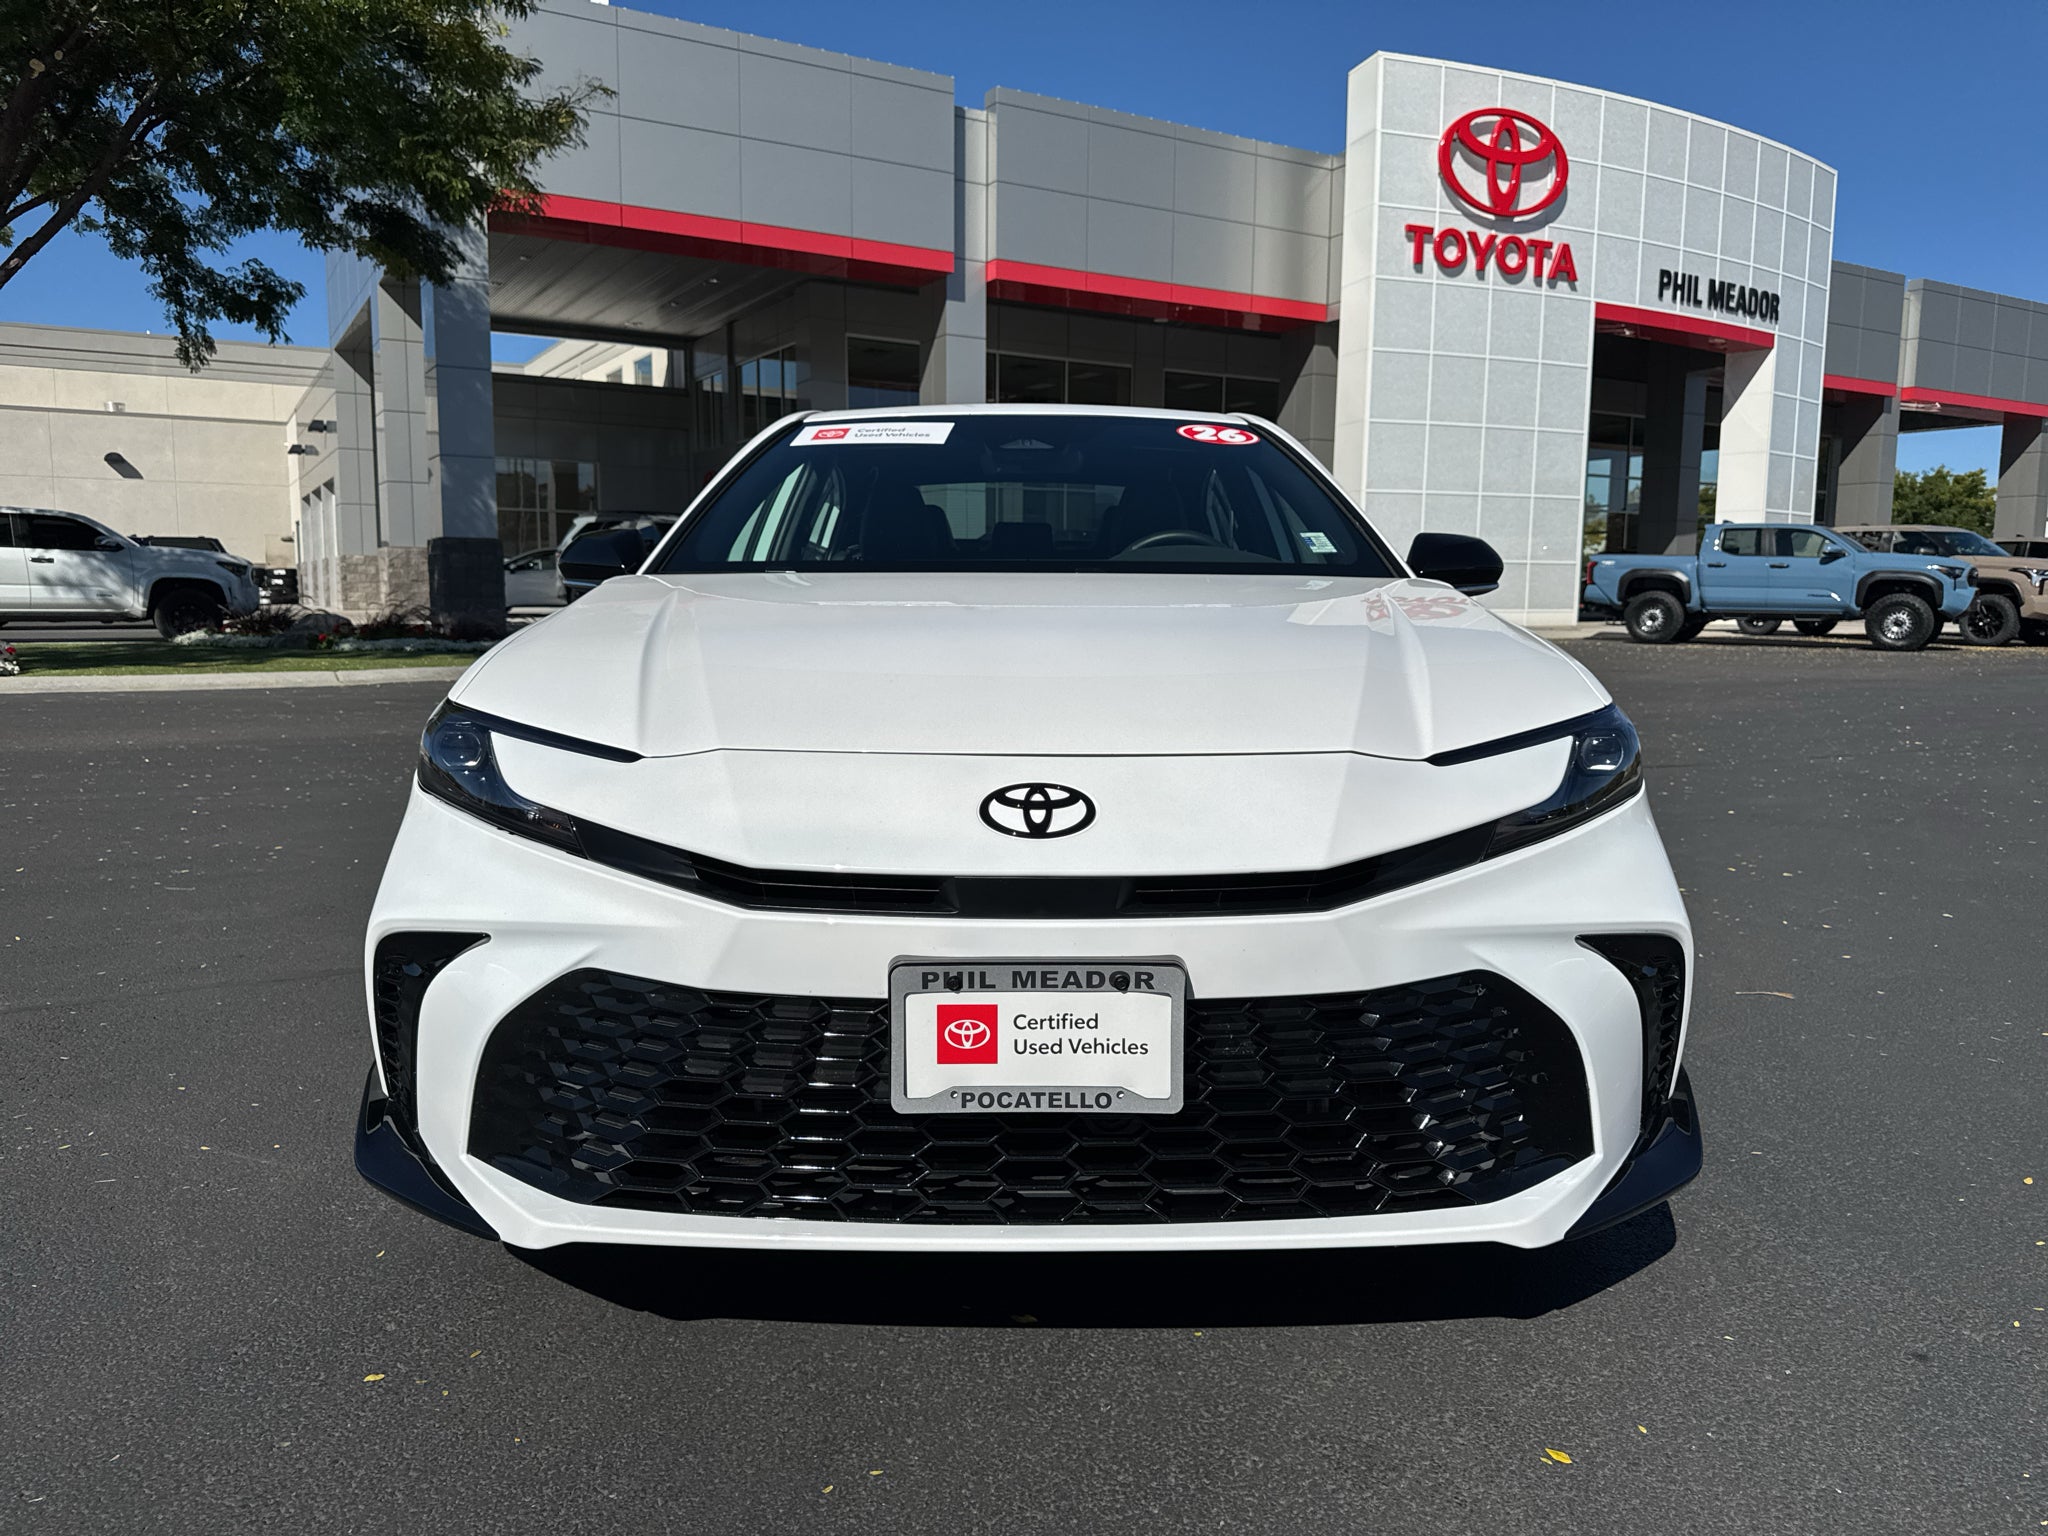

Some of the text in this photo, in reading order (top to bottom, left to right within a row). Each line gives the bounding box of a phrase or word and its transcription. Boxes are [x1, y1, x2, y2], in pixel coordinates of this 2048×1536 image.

[1405, 224, 1578, 282] TOYOTA
[1659, 269, 1780, 323] PHIL MEADOR
[1191, 427, 1248, 443] 26
[1013, 1013, 1099, 1030] Certified
[1013, 1038, 1149, 1055] Used Vehicles
[961, 1092, 1112, 1109] POCATELLO
